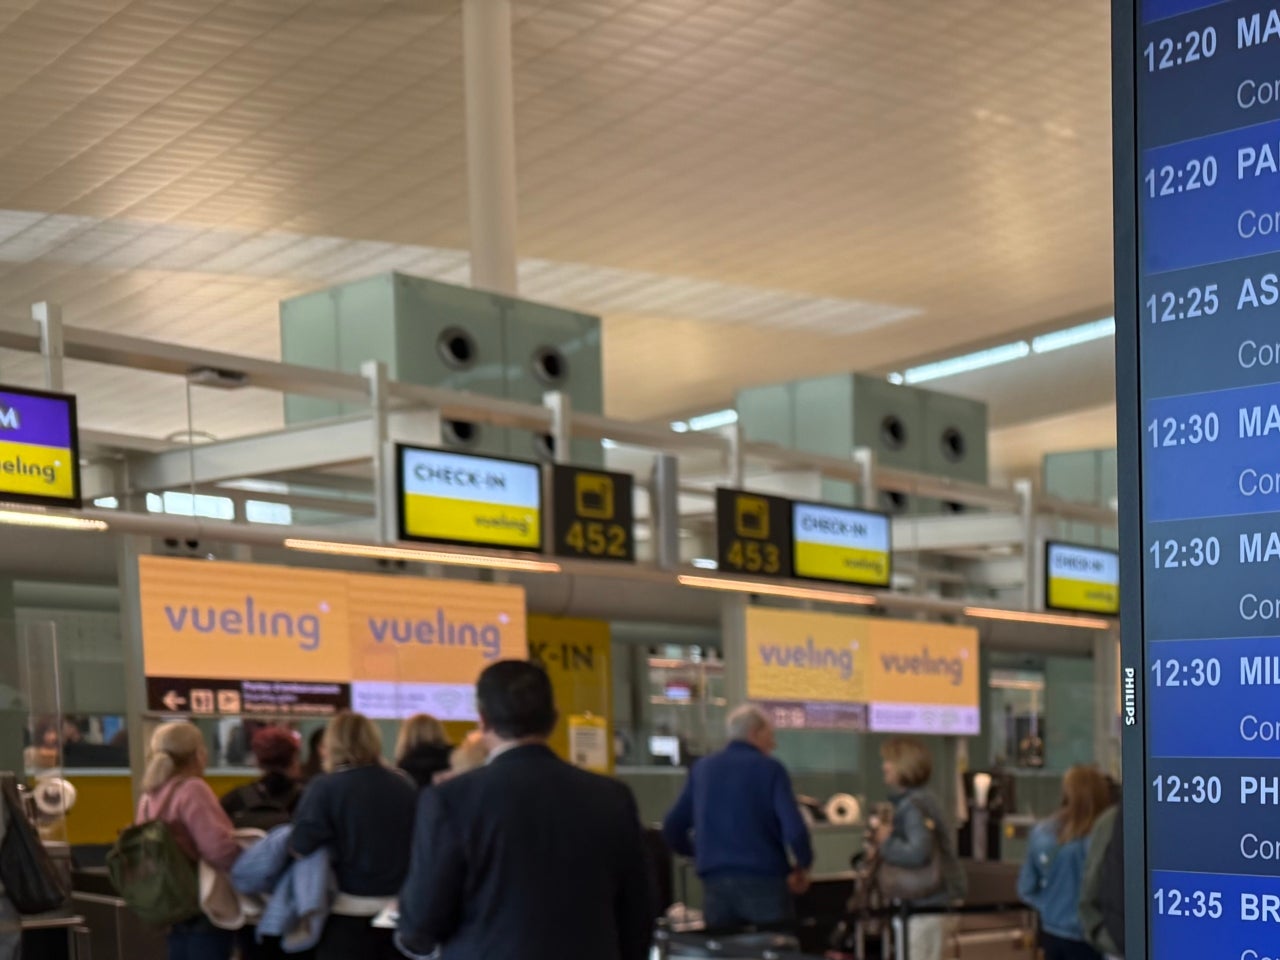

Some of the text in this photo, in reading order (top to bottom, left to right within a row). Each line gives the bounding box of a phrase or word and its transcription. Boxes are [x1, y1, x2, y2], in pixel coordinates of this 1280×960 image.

[1144, 26, 1217, 72] 12:20
[1145, 156, 1218, 198] 12:20
[1146, 284, 1219, 324] 12:25
[1148, 412, 1219, 448] 12:30
[0, 456, 55, 484] eling
[414, 463, 506, 490] CHECK-IN
[566, 521, 627, 556] 452
[727, 540, 780, 573] 453
[1149, 536, 1220, 569] 12:30
[164, 596, 321, 651] vueling
[368, 608, 501, 658] vueling
[759, 635, 853, 680] vueling
[880, 647, 963, 686] vueling
[1151, 657, 1221, 687] 12:30
[1125, 667, 1135, 726] PHILIPS
[1152, 775, 1222, 804] 12:30
[1154, 888, 1223, 919] 12:35
